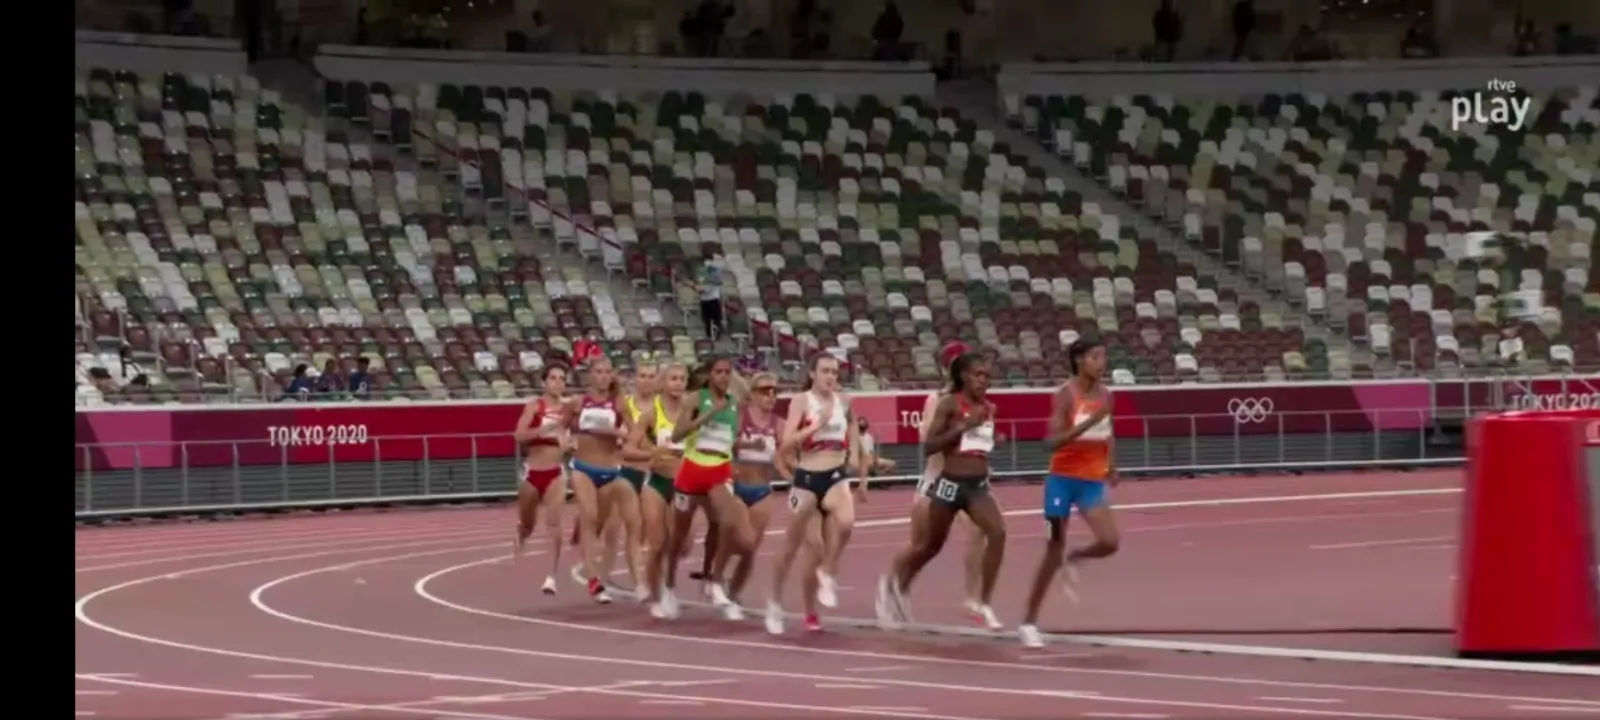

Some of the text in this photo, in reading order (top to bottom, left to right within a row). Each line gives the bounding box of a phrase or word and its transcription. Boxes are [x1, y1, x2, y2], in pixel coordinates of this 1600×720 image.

[1512, 393, 1600, 411] TOKYO 202
[267, 424, 368, 446] TOKYO 2020
